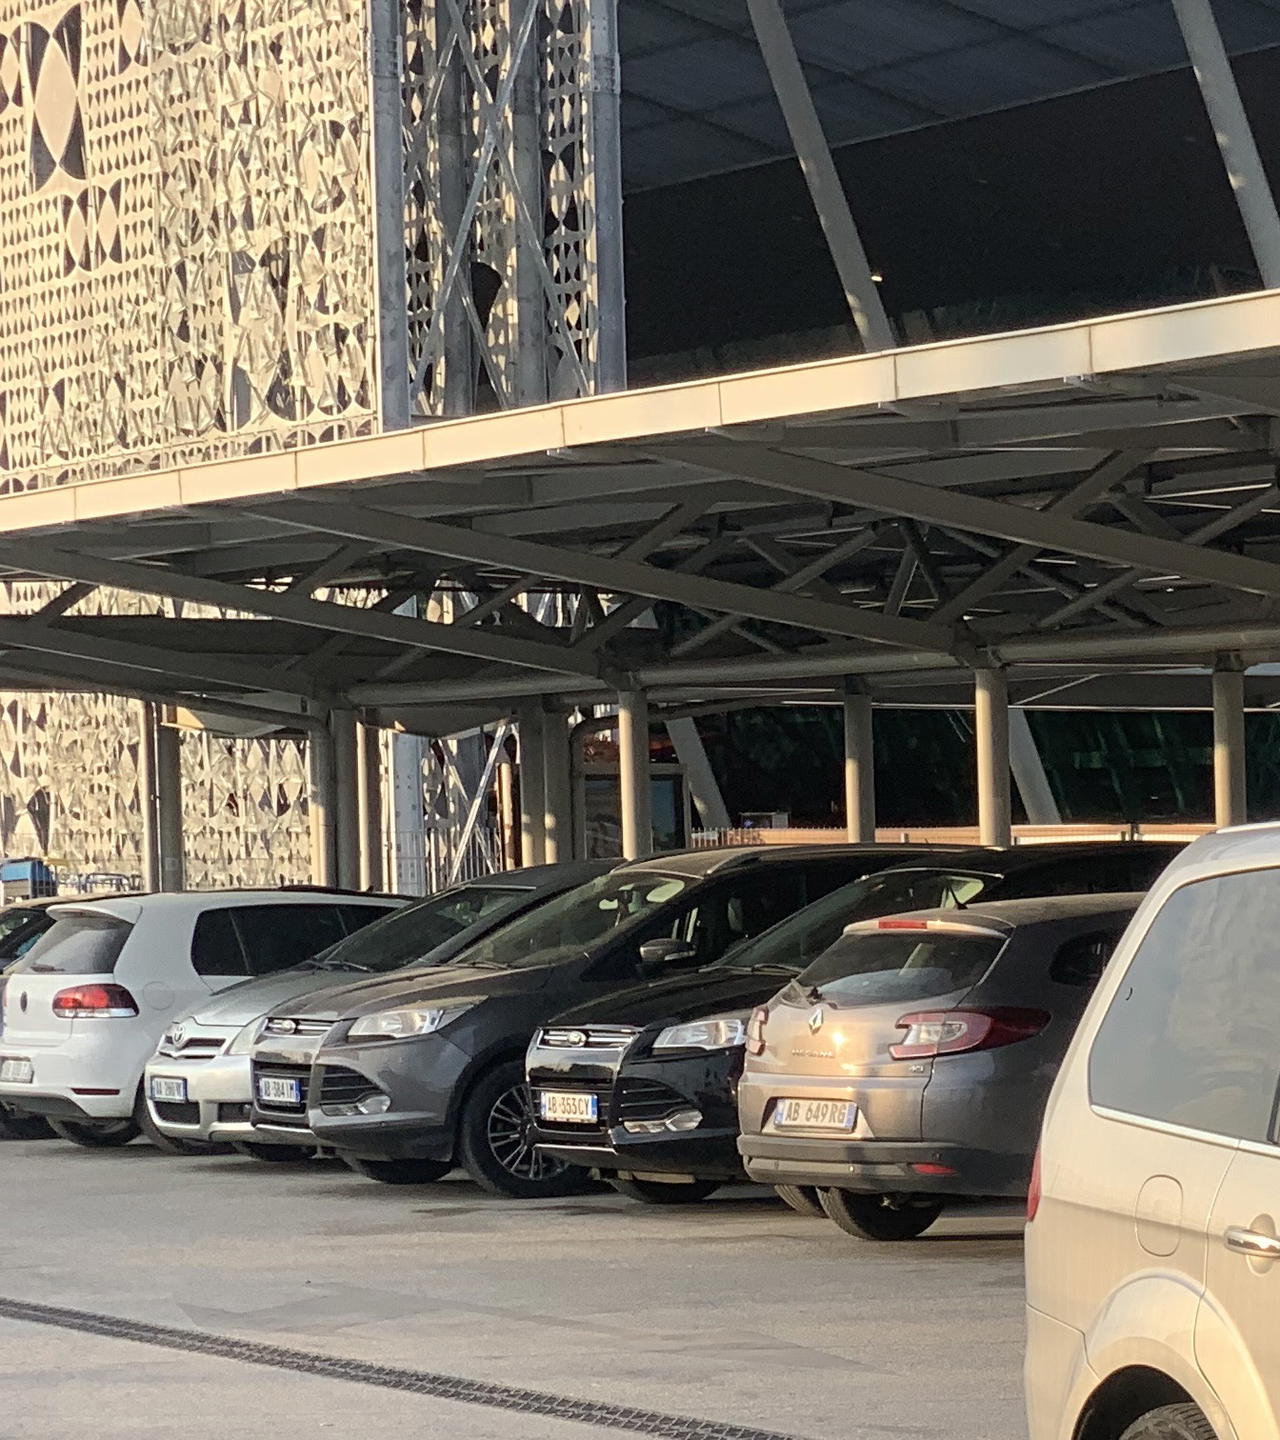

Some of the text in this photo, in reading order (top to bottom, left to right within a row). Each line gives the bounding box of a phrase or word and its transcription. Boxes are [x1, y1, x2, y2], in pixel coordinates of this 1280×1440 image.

[785, 1102, 847, 1124] AB 649 RG
